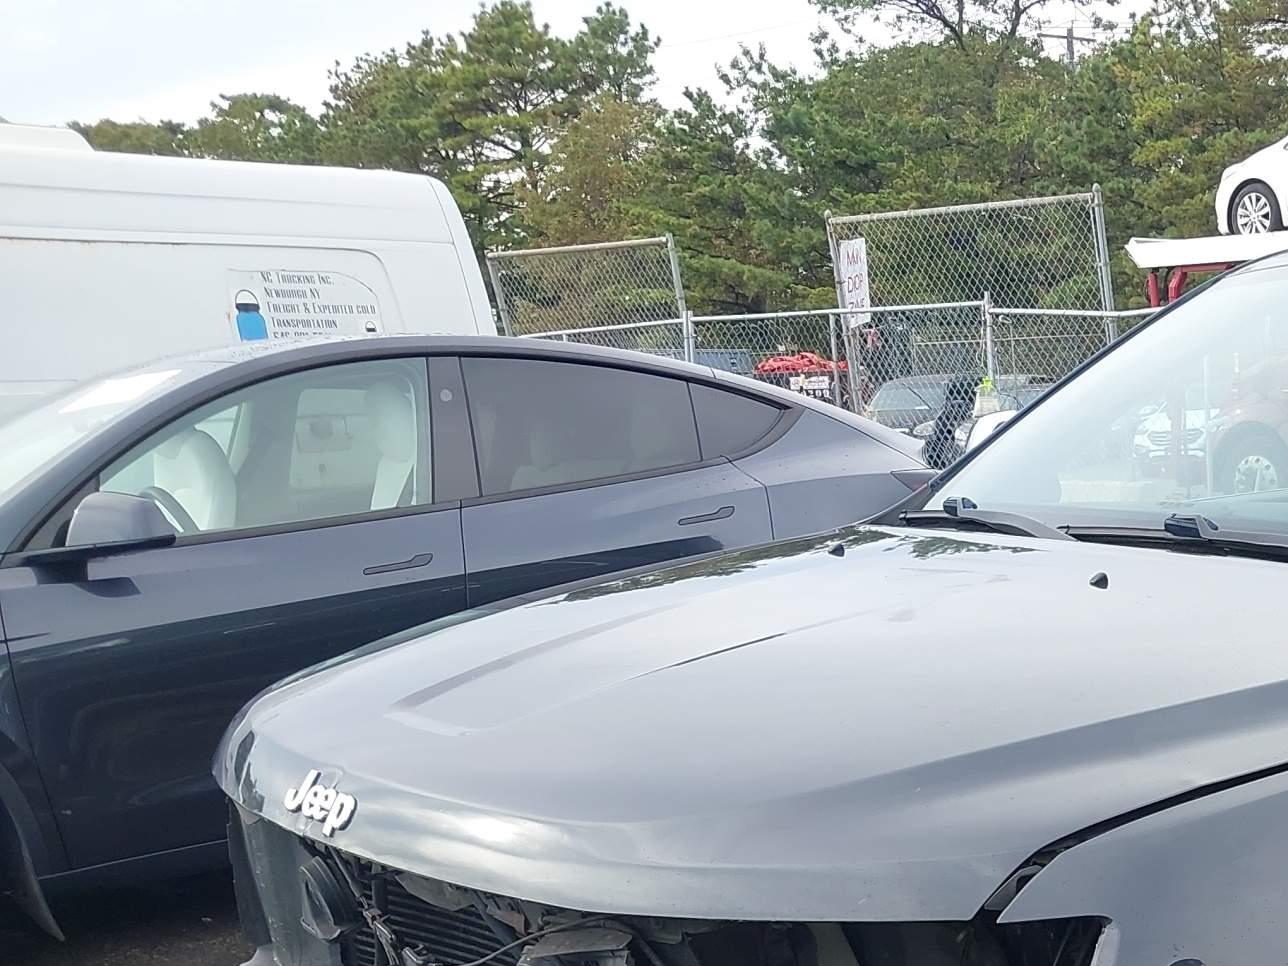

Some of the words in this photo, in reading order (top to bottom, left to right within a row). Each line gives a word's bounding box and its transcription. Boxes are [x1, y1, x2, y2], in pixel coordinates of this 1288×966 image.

[309, 287, 320, 299] NY
[303, 302, 310, 313] &
[284, 768, 357, 838] Jeep
